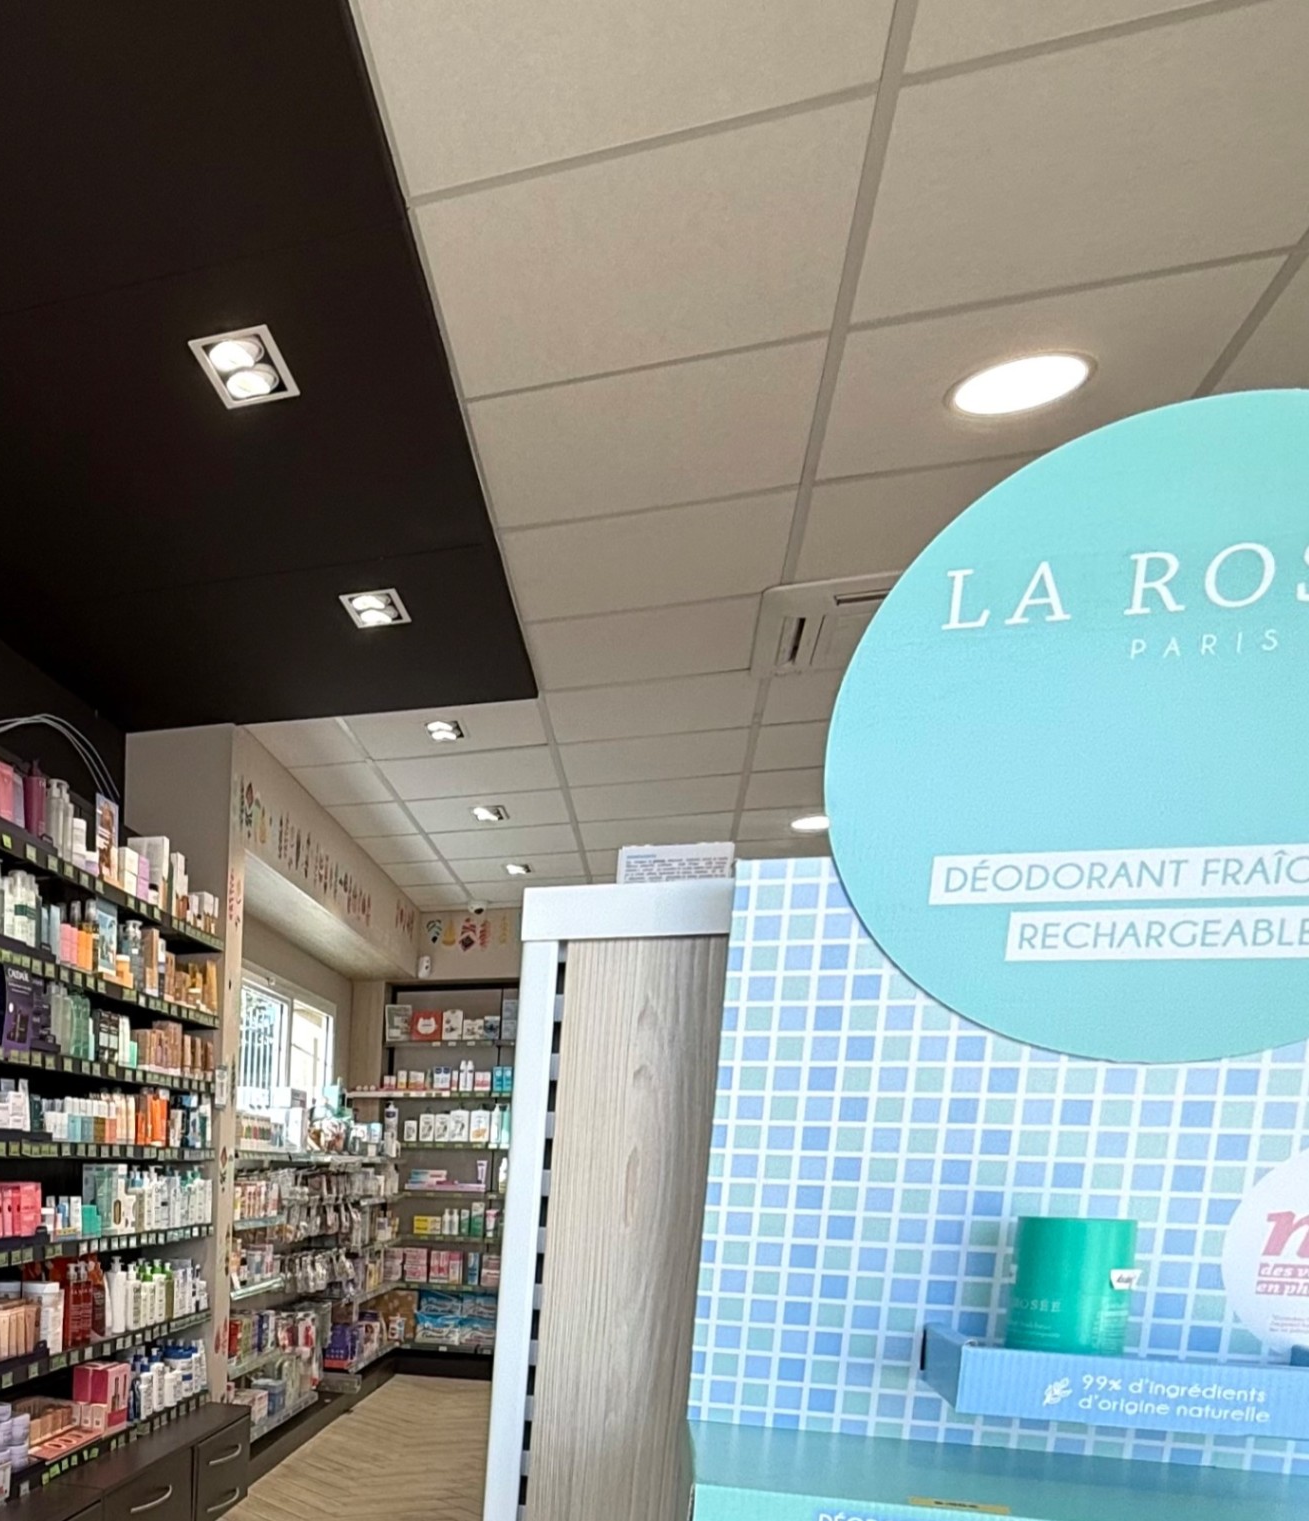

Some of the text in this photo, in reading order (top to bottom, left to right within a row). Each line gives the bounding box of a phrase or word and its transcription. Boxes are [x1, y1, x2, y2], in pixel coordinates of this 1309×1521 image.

[941, 560, 1072, 630] LA
[1130, 629, 1279, 660] PARIS
[944, 859, 1189, 894] DÉODORANT
[1082, 1374, 1267, 1404] 99% d'ingrédients
[1078, 1394, 1271, 1424] d'origine naturelle
